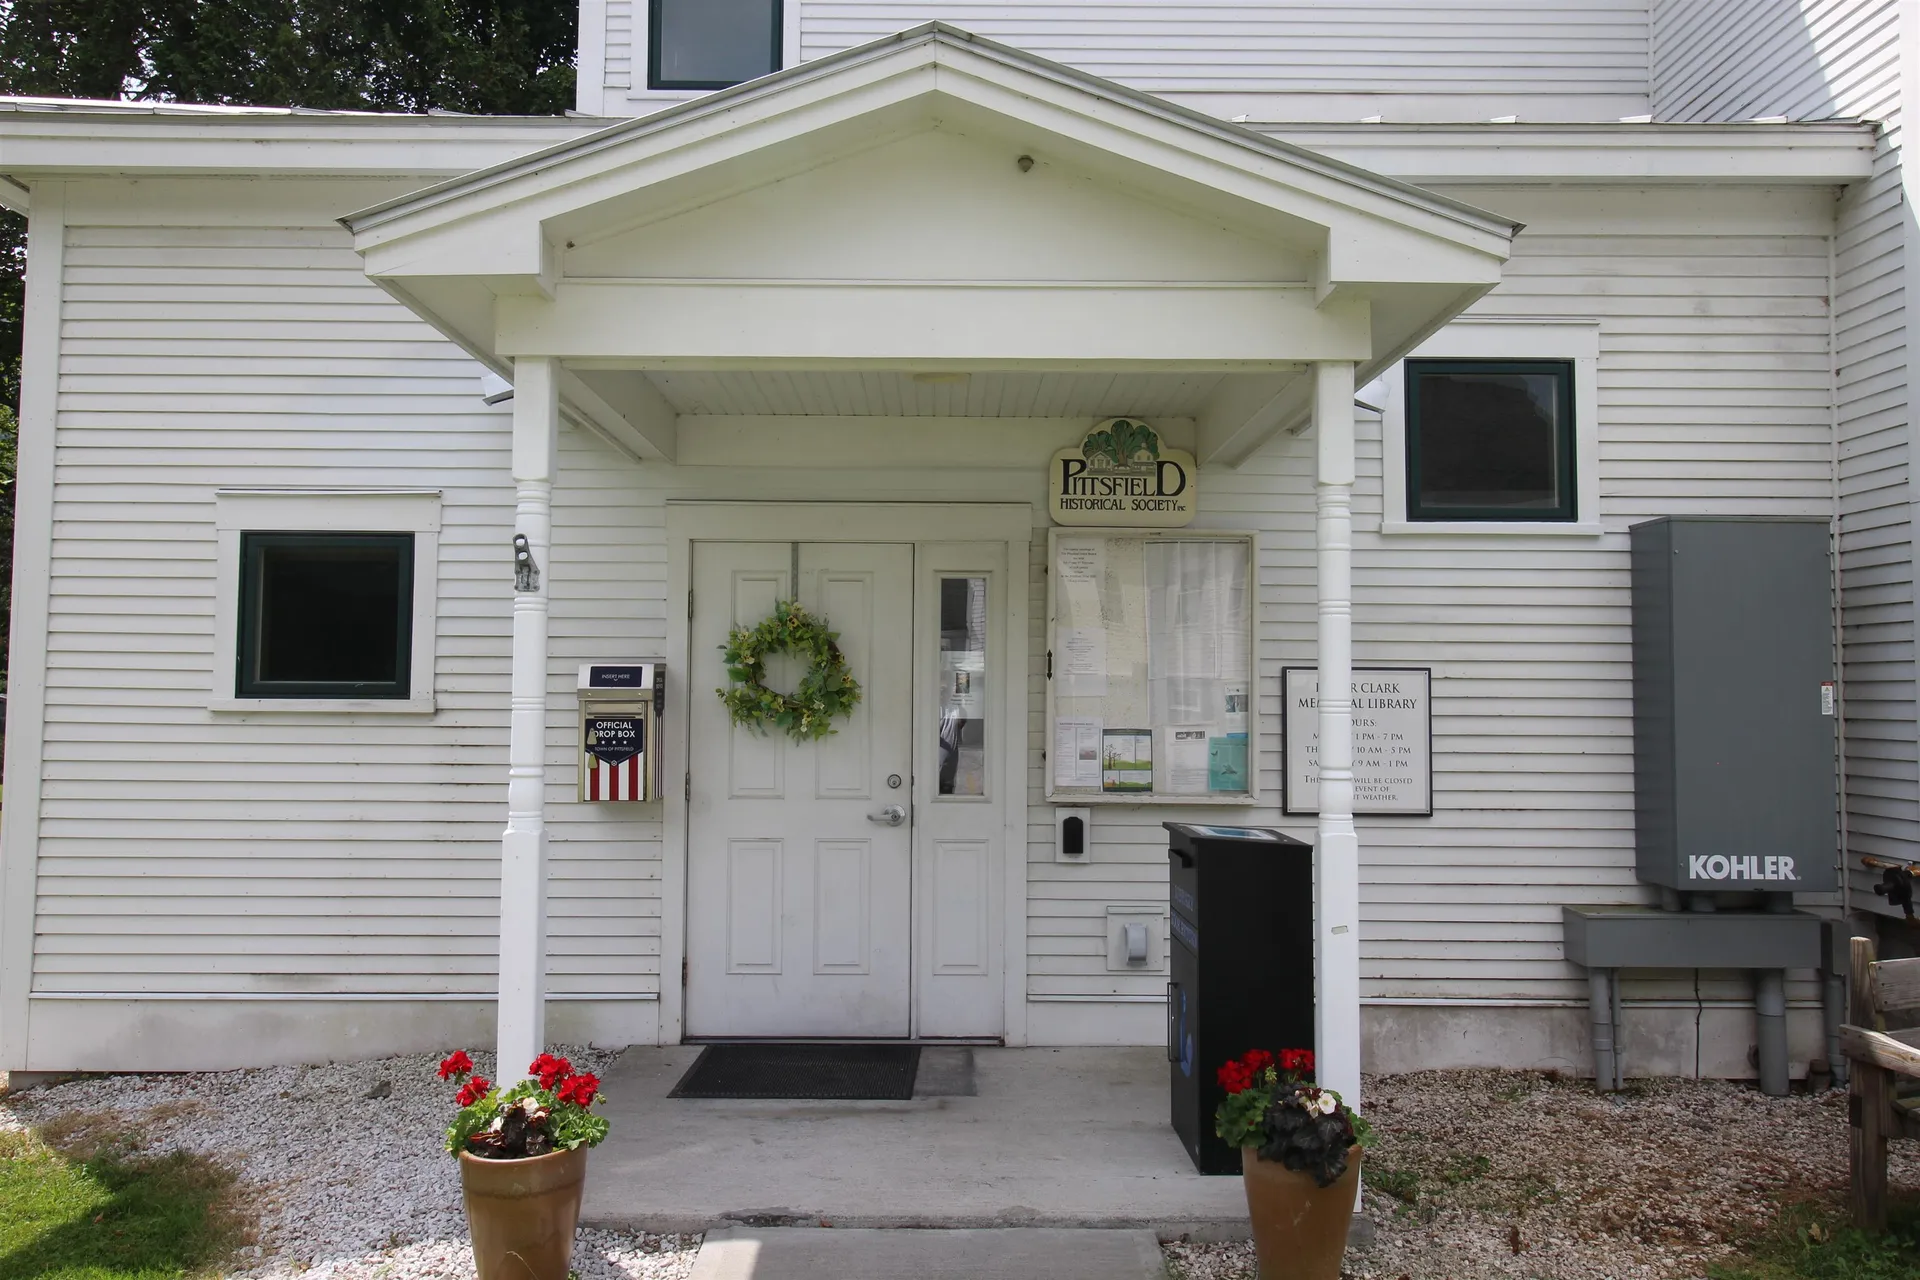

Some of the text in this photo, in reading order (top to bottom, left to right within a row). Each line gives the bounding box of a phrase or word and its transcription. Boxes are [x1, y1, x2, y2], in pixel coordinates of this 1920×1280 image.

[1060, 458, 1187, 497] PITTSFIELD
[1060, 498, 1126, 511] HISTORICAL
[1131, 499, 1178, 512] SOCIETY
[1360, 682, 1401, 694] CLARK
[1368, 698, 1417, 709] LIBRARY
[596, 721, 633, 729] OFFICIAL
[617, 730, 636, 738] BOX
[1391, 733, 1404, 741] PM
[1689, 855, 1796, 880] KOHLER
